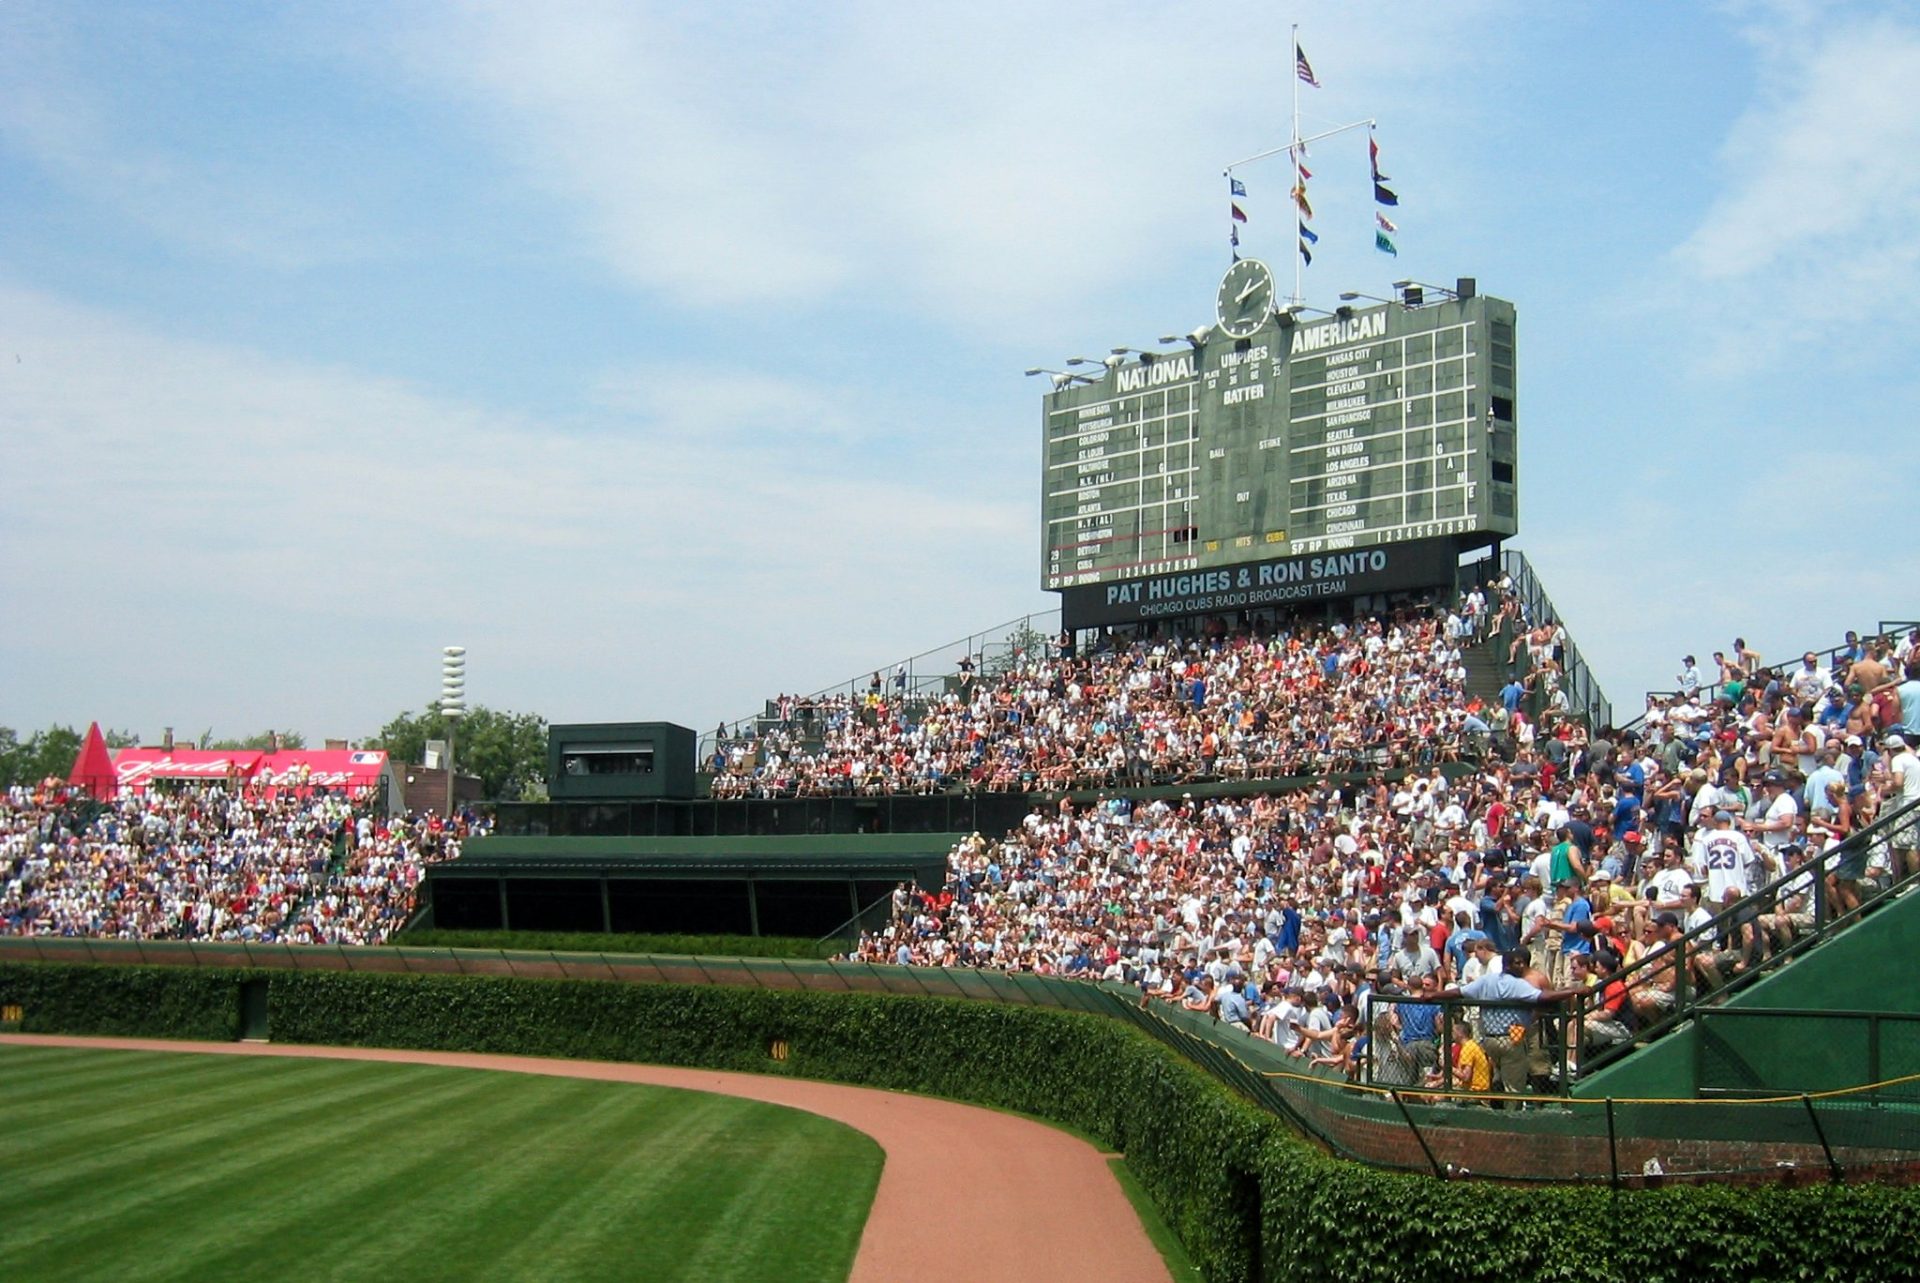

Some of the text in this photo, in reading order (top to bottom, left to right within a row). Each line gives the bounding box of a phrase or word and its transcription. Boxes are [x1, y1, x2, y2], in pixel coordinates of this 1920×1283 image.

[1290, 312, 1386, 354] AMERICAN
[1221, 346, 1268, 368] UMPIRES
[1326, 348, 1371, 367] KANSAS CITY
[1117, 356, 1198, 393] NATIONAL
[1326, 366, 1358, 382] HOUSTON
[1224, 384, 1264, 405] BATTER
[1326, 380, 1366, 397] CLEVELAND
[1326, 395, 1366, 411] MILWAUKEE
[1079, 432, 1109, 446] COLORADO
[1326, 427, 1354, 442] SEATTLE
[1210, 448, 1225, 459] BALL
[1326, 442, 1364, 457] SAN DIEGO
[1326, 456, 1369, 472] LOS ANGELES
[1236, 491, 1250, 502] OUT
[1326, 490, 1347, 503] TEXAS
[1326, 505, 1356, 518] CHICAGO
[1326, 520, 1365, 534] CINCINNATI
[1291, 543, 1304, 555] SP
[1309, 540, 1321, 552] RP
[1328, 536, 1354, 550] INNING
[1386, 531, 1392, 542] 2
[1397, 529, 1401, 540] 3
[1407, 528, 1412, 539] 4
[1417, 527, 1422, 537] 5
[1427, 525, 1432, 536] 6
[1437, 524, 1442, 535] 7
[1447, 522, 1453, 533] 8
[1458, 521, 1464, 532] 9
[1468, 520, 1476, 531] 10
[1050, 578, 1060, 588] SP
[1126, 567, 1130, 578] 2
[1134, 566, 1139, 576] 3
[1142, 565, 1146, 575] 4
[1150, 564, 1155, 574] 5
[1158, 563, 1163, 573] 6
[1166, 562, 1171, 572] 7
[1174, 560, 1179, 571] 8
[1183, 559, 1188, 570] 9
[1190, 558, 1198, 569] 10
[1107, 550, 1386, 605] PAT HUGHES & RON SANTO
[1140, 580, 1346, 616] CHICAGO CUBS RADIO BROADCAST TEAM
[1709, 850, 1736, 870] 23
